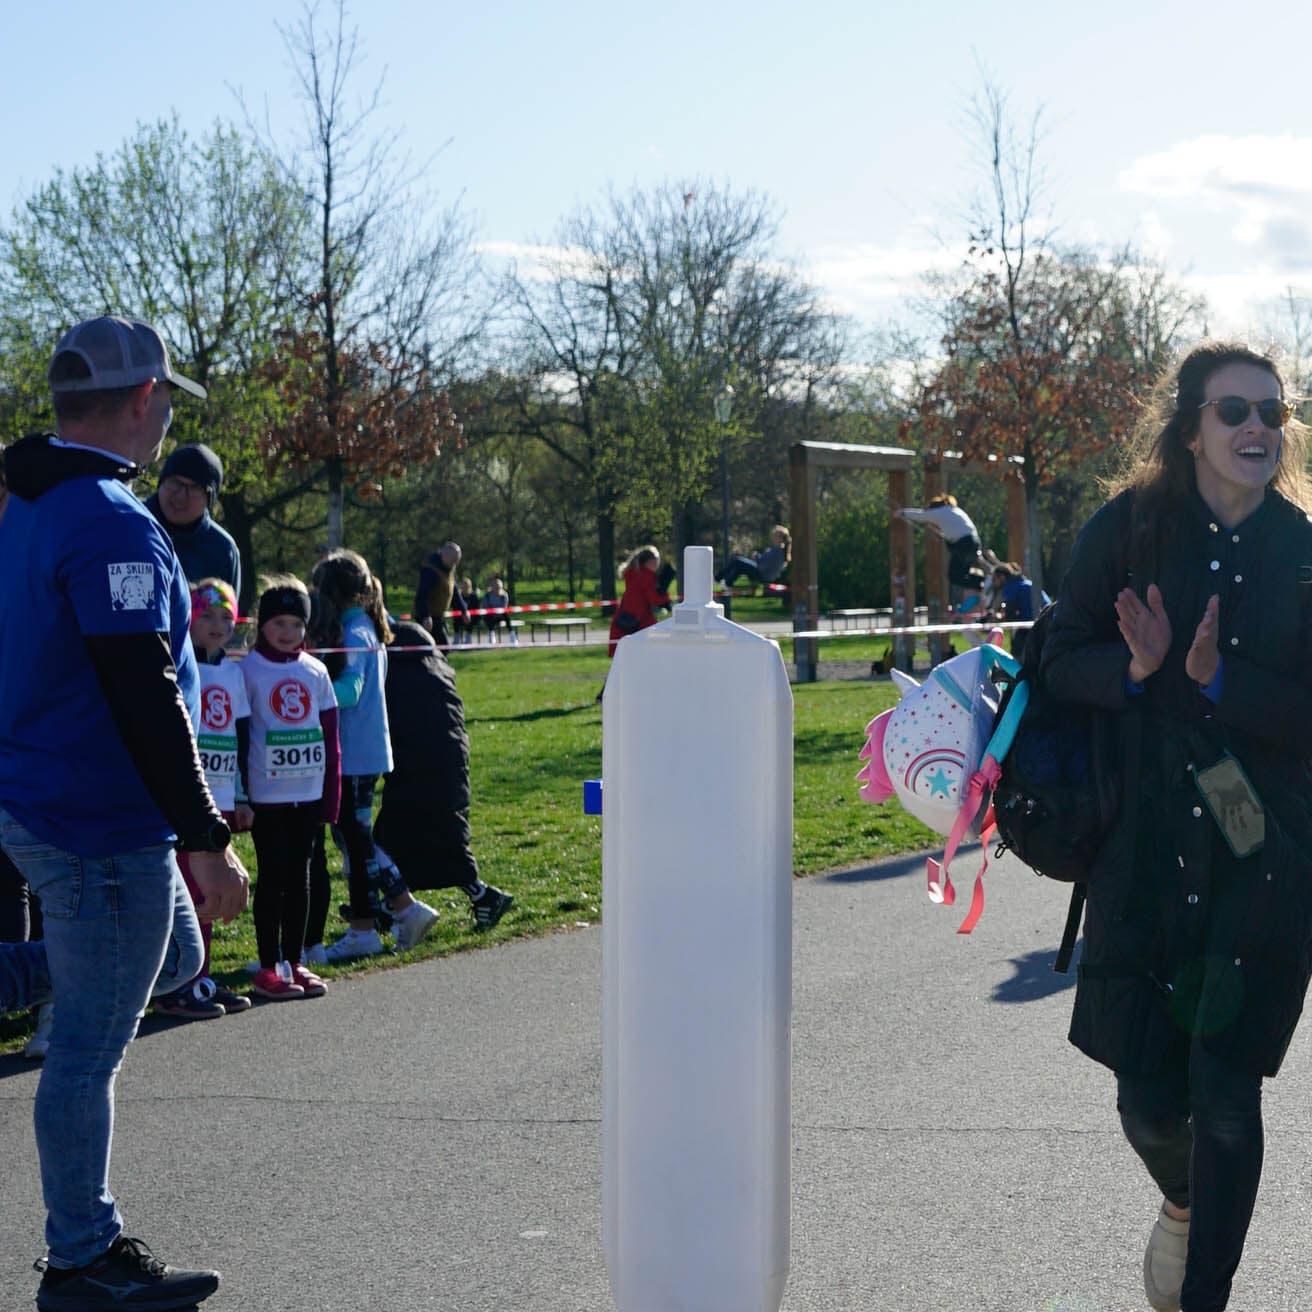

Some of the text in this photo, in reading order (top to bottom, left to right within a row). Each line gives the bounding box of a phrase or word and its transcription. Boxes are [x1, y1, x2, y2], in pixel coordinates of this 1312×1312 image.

[110, 565, 122, 576] ZA
[199, 751, 236, 773] 3012
[271, 744, 322, 767] 3016
